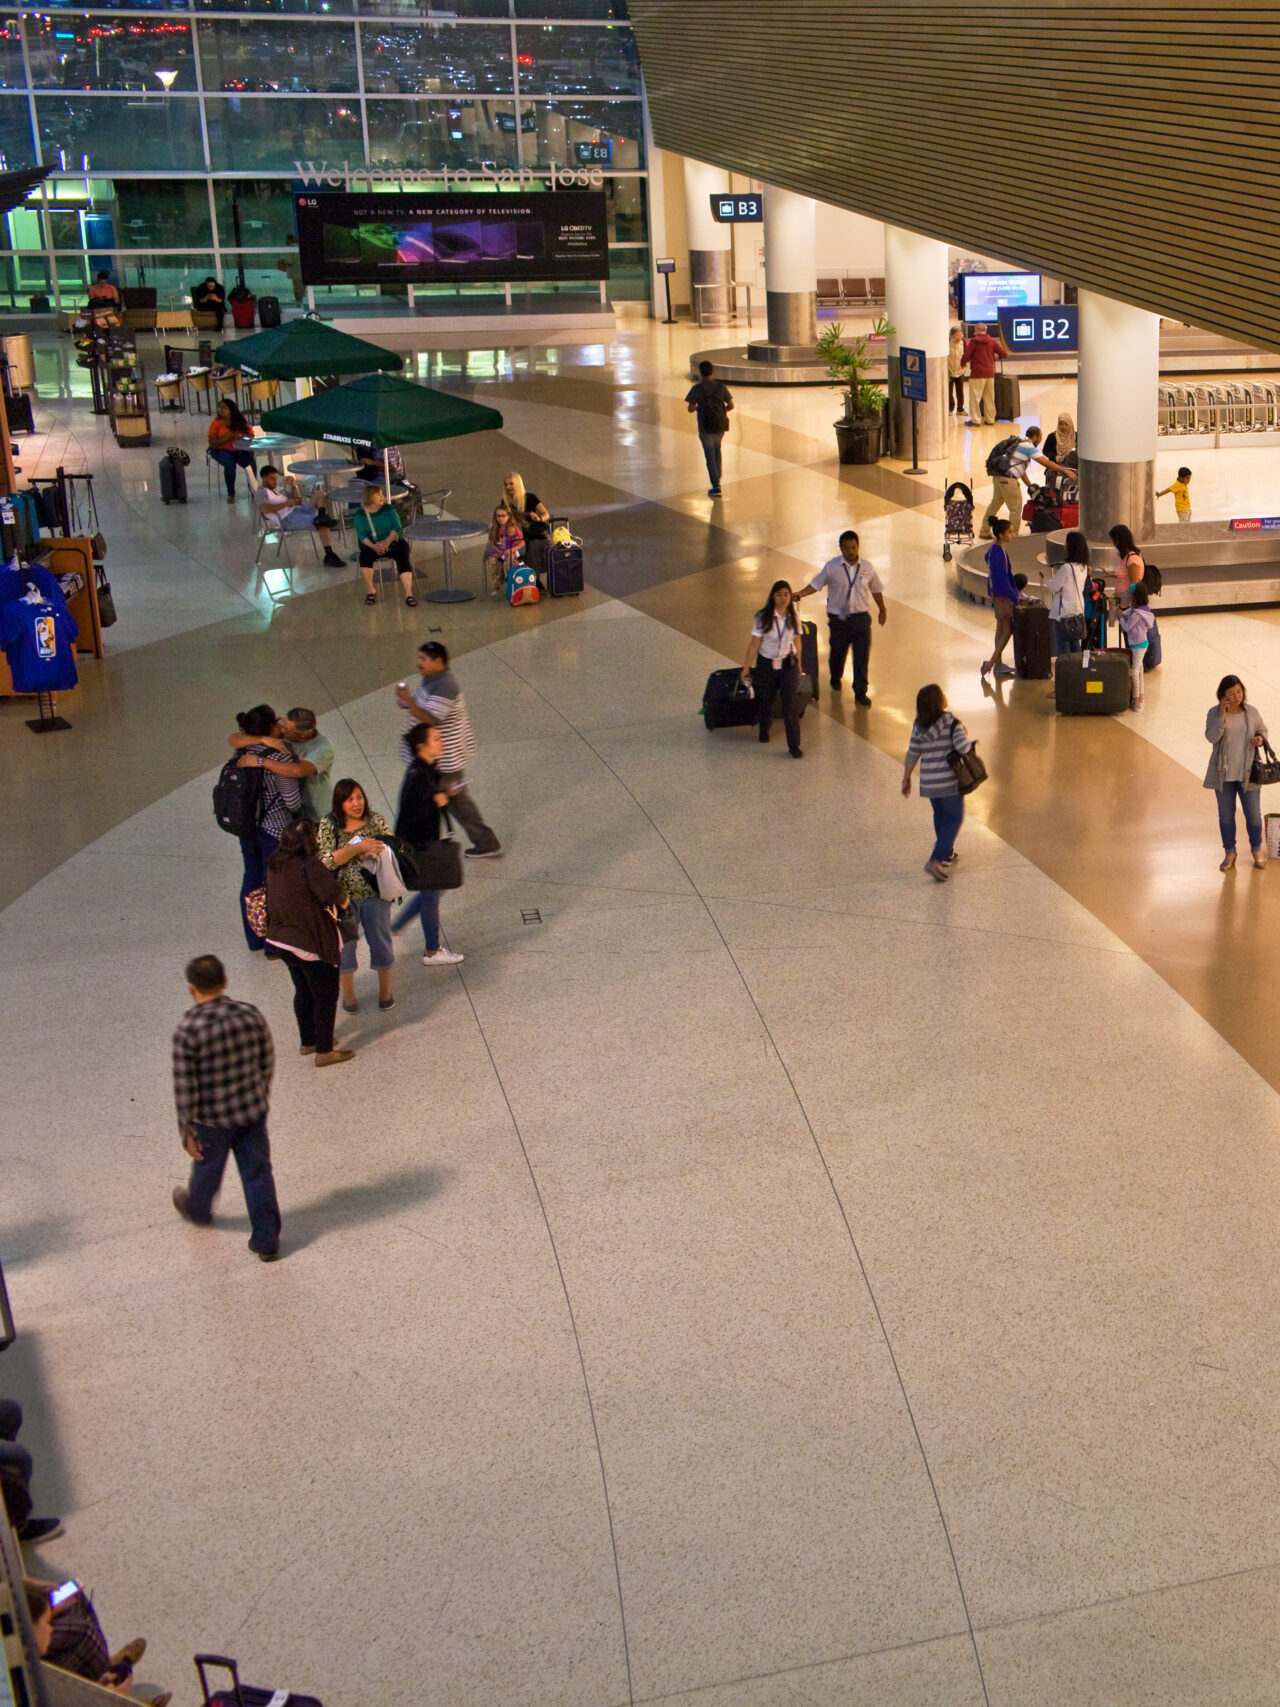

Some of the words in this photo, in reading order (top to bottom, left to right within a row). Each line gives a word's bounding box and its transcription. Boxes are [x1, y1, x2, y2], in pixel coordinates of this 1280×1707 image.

[293, 160, 431, 187] Welcome
[440, 163, 471, 186] to
[481, 160, 534, 187] San
[545, 160, 604, 187] Jose
[738, 201, 758, 216] B3
[1042, 319, 1070, 340] B2
[323, 433, 351, 443] STARBUCKS
[352, 438, 371, 447] COFFEE
[1234, 521, 1261, 529] Caution
